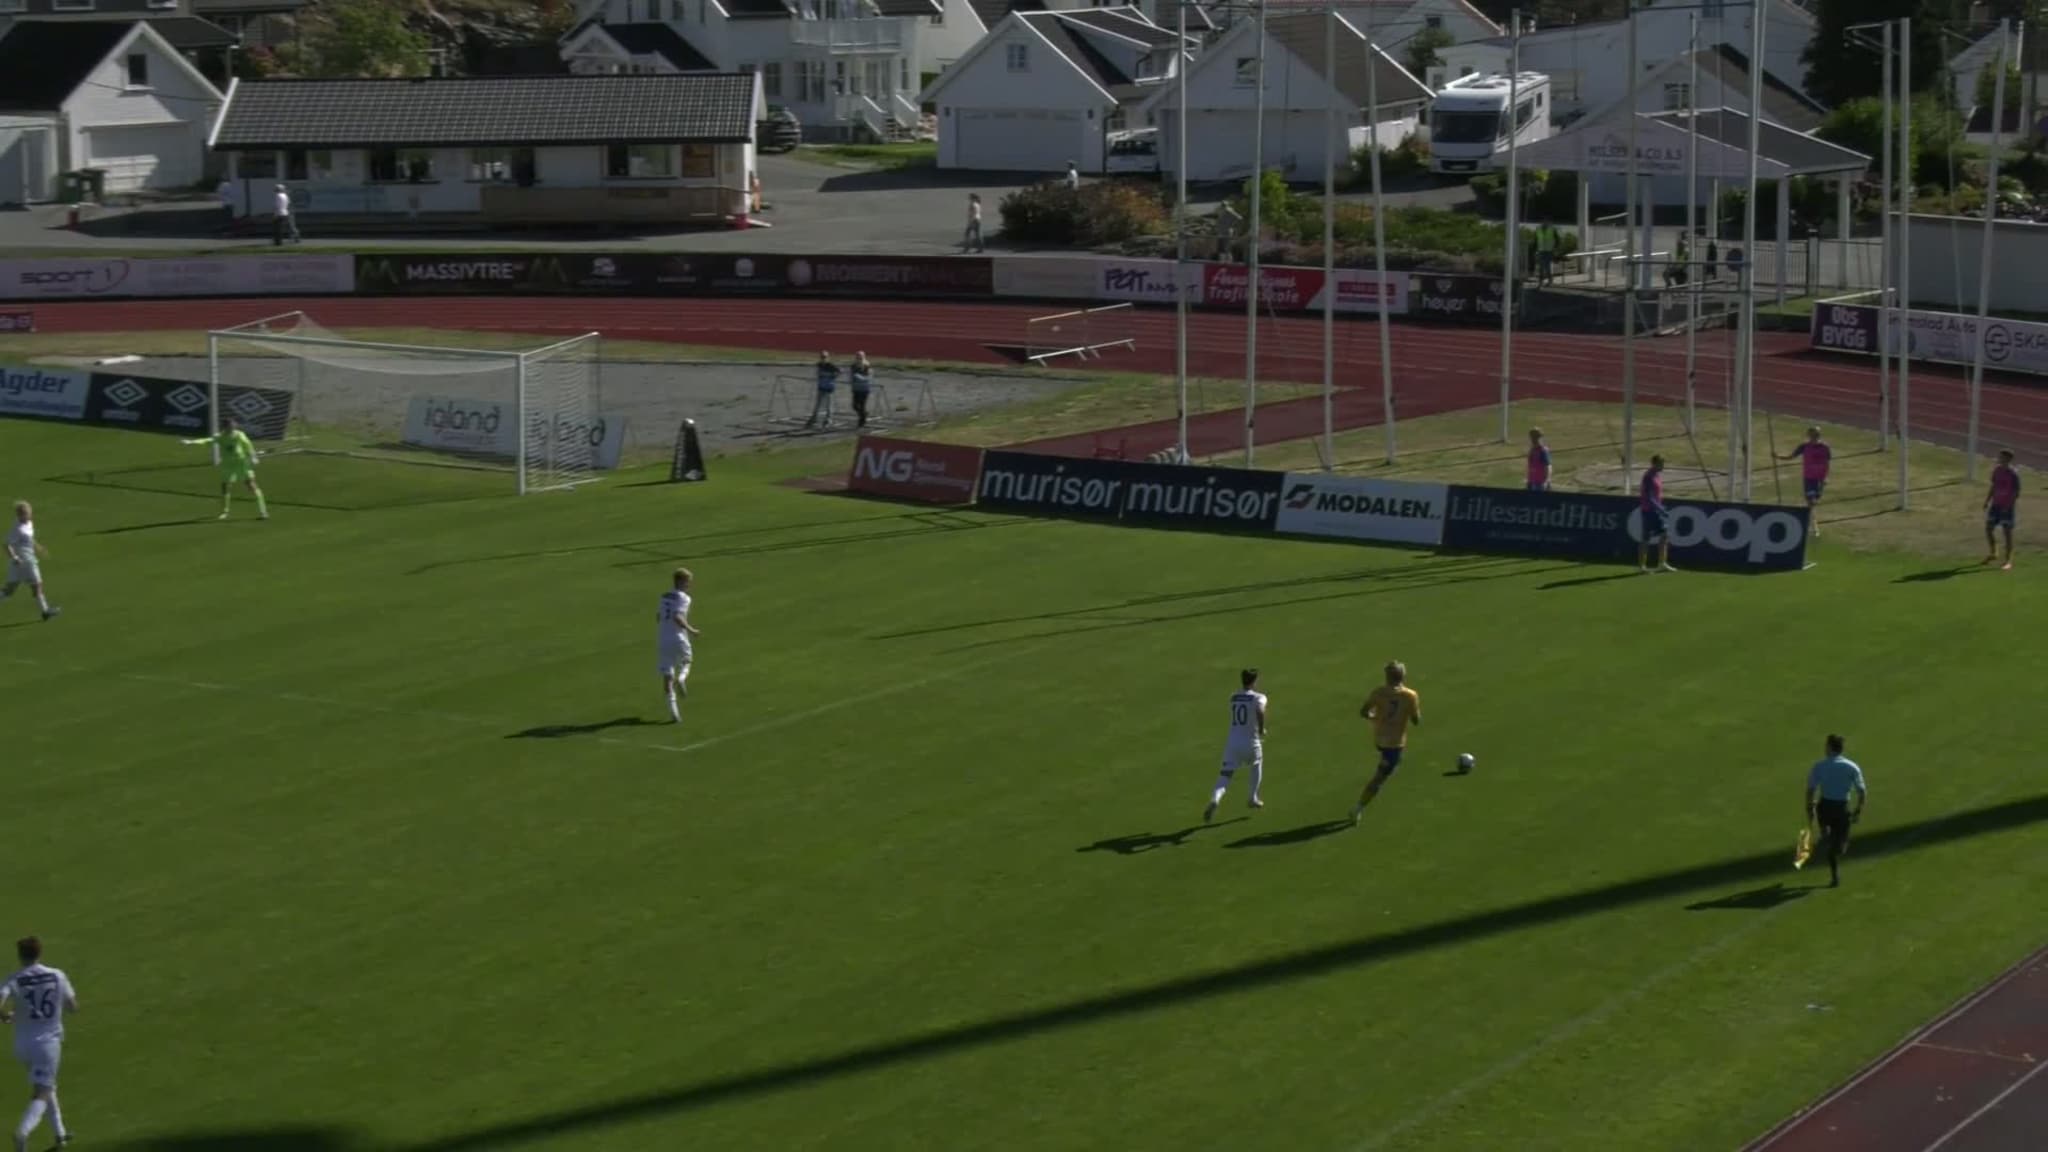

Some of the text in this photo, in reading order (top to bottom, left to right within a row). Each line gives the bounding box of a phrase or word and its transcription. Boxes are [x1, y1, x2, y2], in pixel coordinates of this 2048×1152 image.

[406, 261, 513, 281] MASSIVTRE
[1822, 326, 1867, 349] BYGG
[854, 448, 913, 483] NG
[981, 464, 1121, 509] murisør
[1127, 476, 1278, 521] murisør
[1450, 495, 1618, 531] LillesandHus
[1232, 703, 1249, 727] 10
[25, 988, 57, 1020] 16
